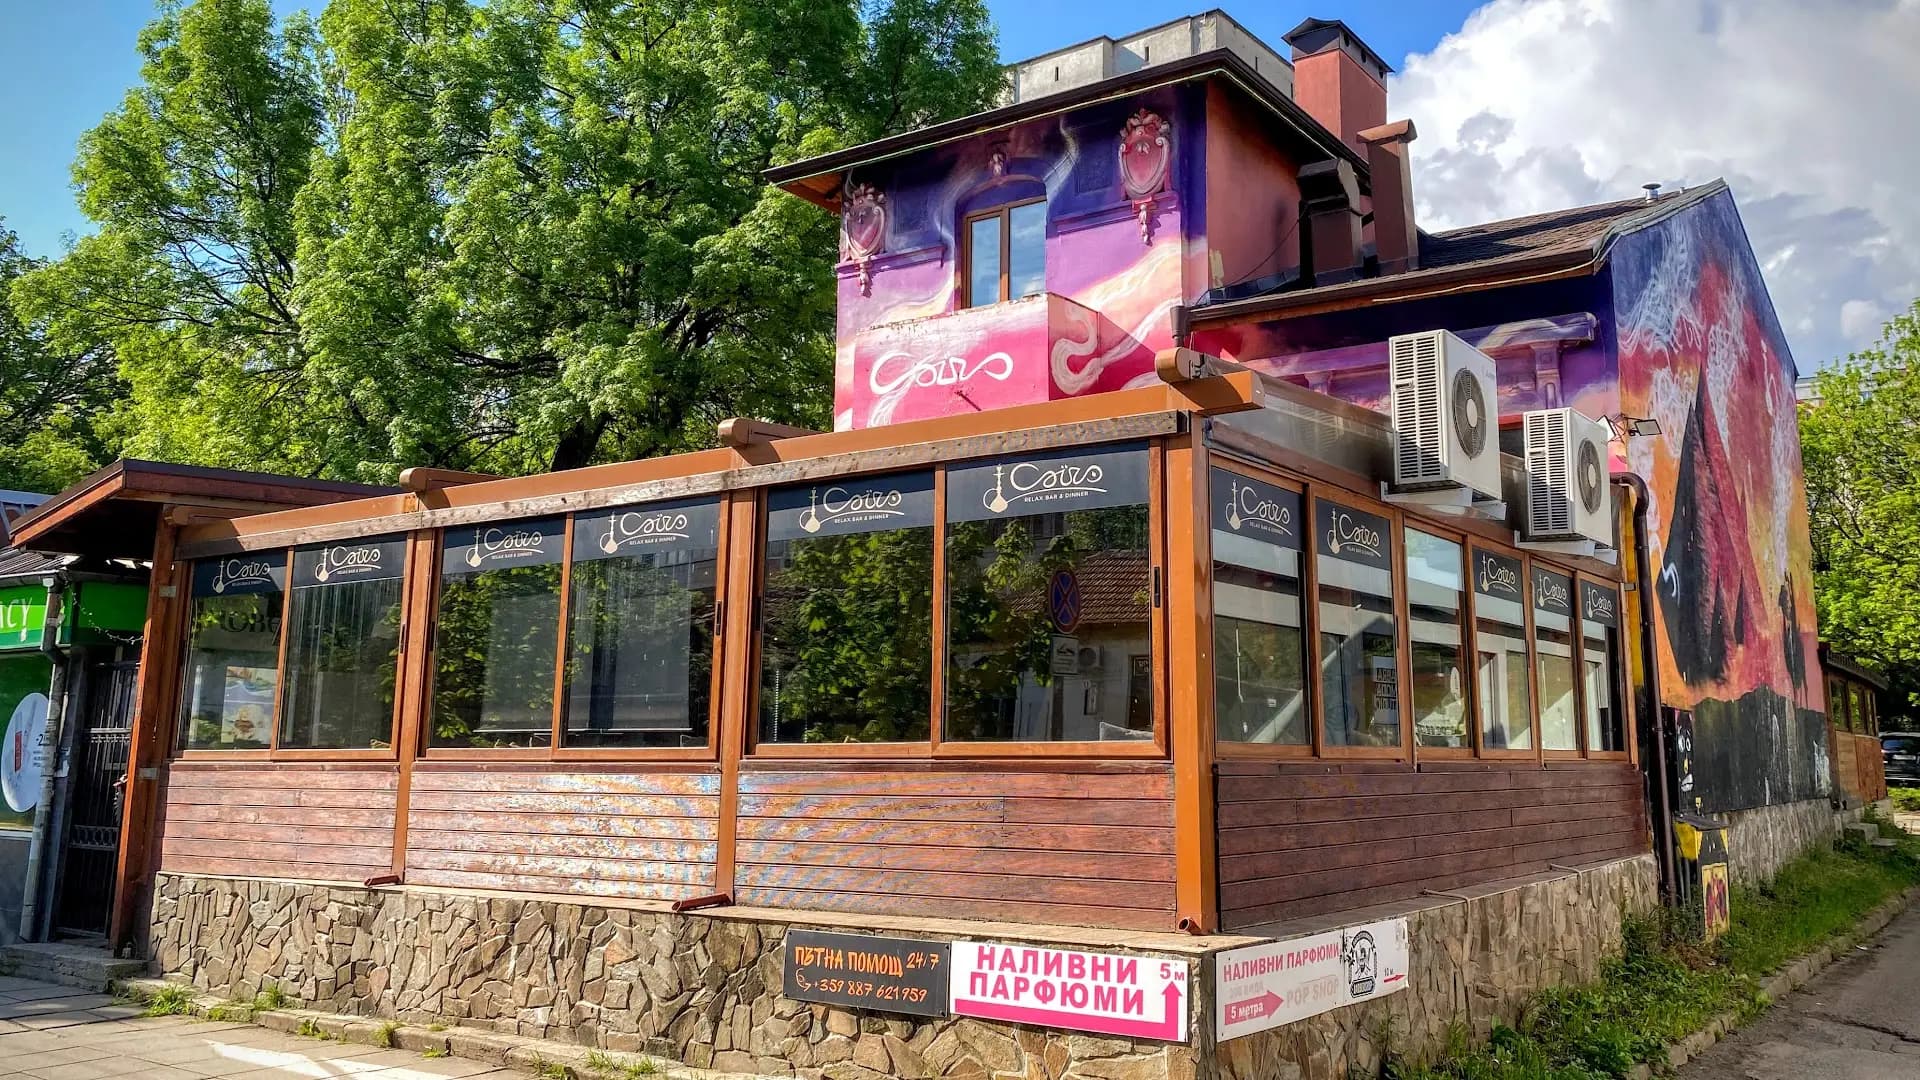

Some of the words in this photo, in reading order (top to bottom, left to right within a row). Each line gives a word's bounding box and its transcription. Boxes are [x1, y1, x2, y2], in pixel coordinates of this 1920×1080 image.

[1024, 495, 1044, 503] RELAX
[1065, 491, 1089, 499] DINNER
[847, 951, 904, 978] ПОМОЩ
[905, 952, 940, 971] 24/7
[977, 945, 1138, 985] НАЛИВНИ
[1159, 962, 1171, 980] 5
[1223, 954, 1283, 983] НАЛИВНИ
[1287, 942, 1339, 969] ПАРФЮМИ
[813, 978, 845, 993] +359
[847, 980, 873, 997] 887
[876, 984, 899, 1000] 621
[901, 987, 928, 1003] 959
[970, 971, 1144, 1015] ПАРФЮМИ
[1231, 1005, 1237, 1019] 5
[1239, 1002, 1264, 1018] метра
